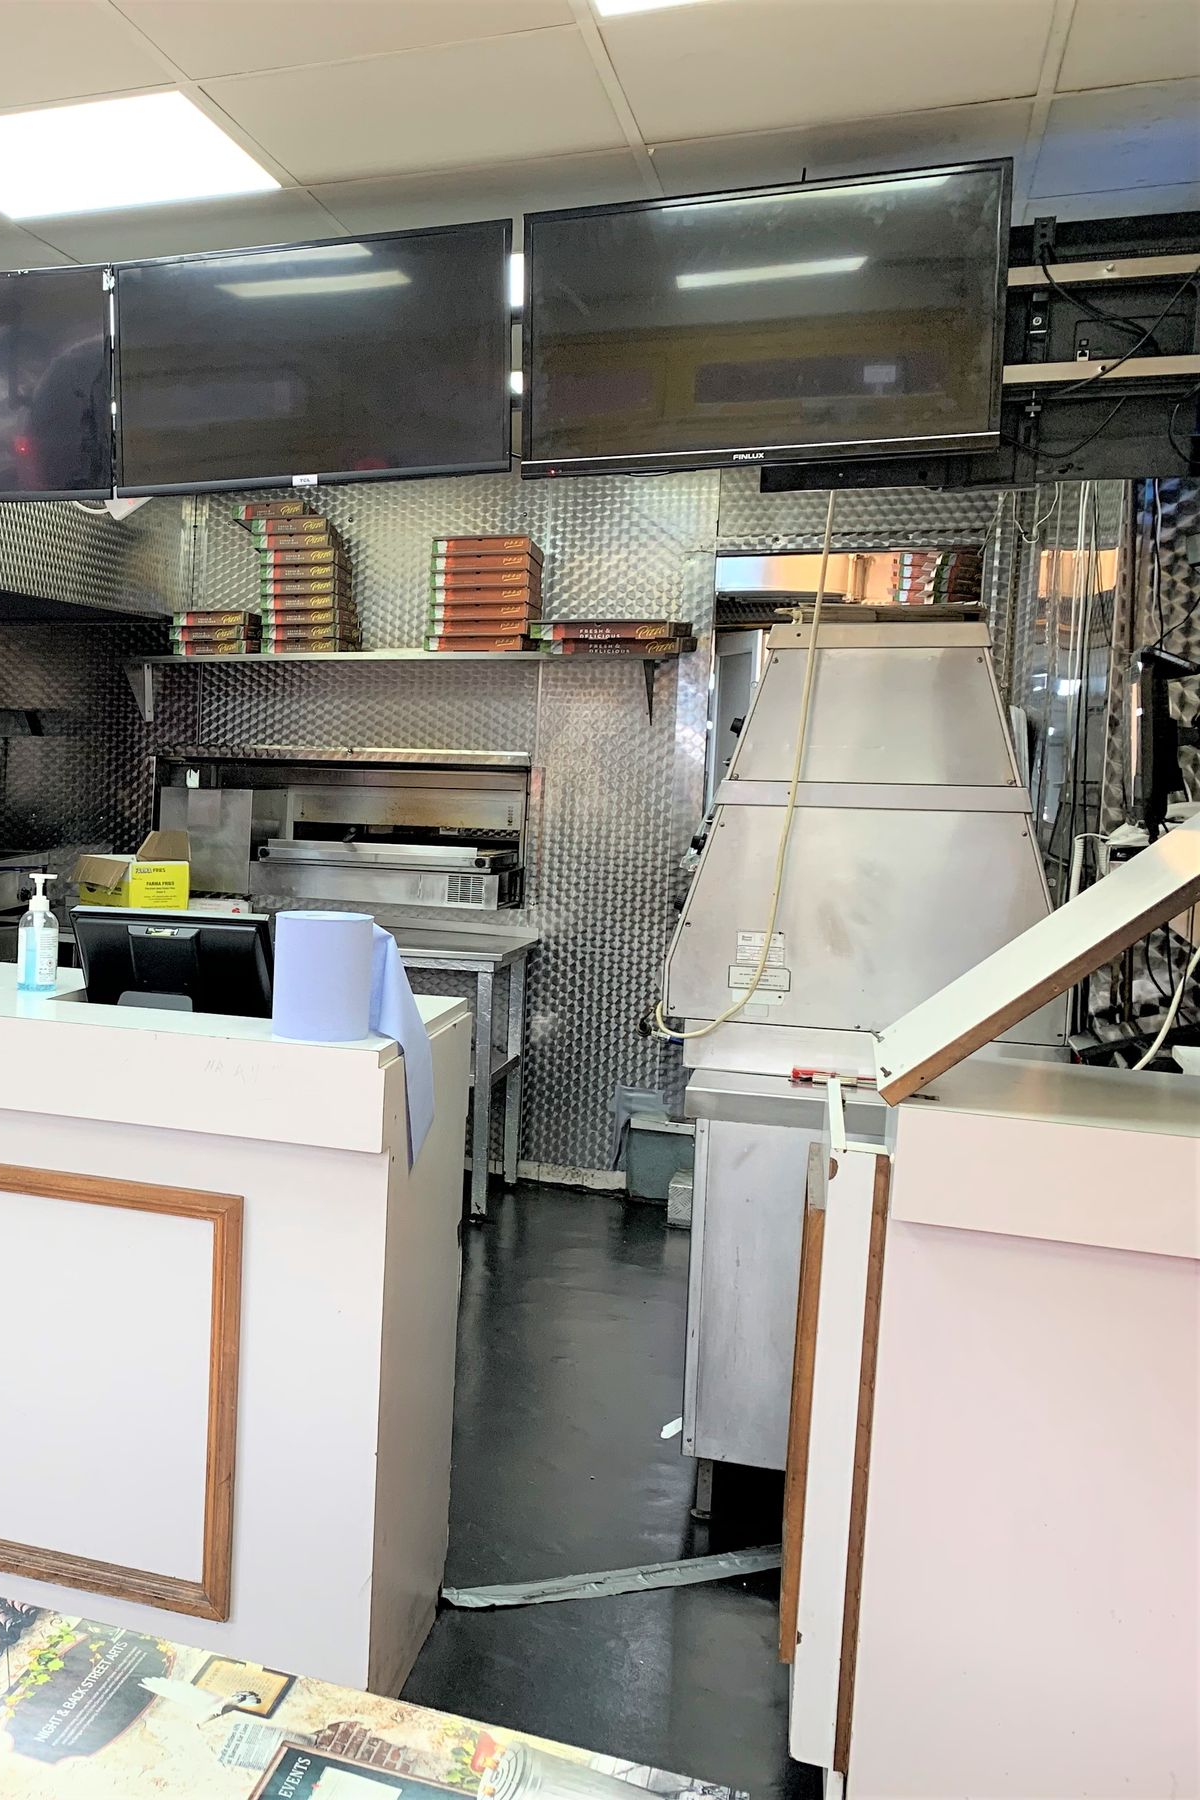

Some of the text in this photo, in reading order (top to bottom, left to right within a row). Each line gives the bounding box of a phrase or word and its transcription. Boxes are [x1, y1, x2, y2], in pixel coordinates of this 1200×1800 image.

[732, 452, 765, 461] FINLUX
[635, 625, 666, 639] Pizza
[34, 1640, 128, 1743] NIGHT & BACK STREET ARTS
[278, 1755, 312, 1799] EVENTS
